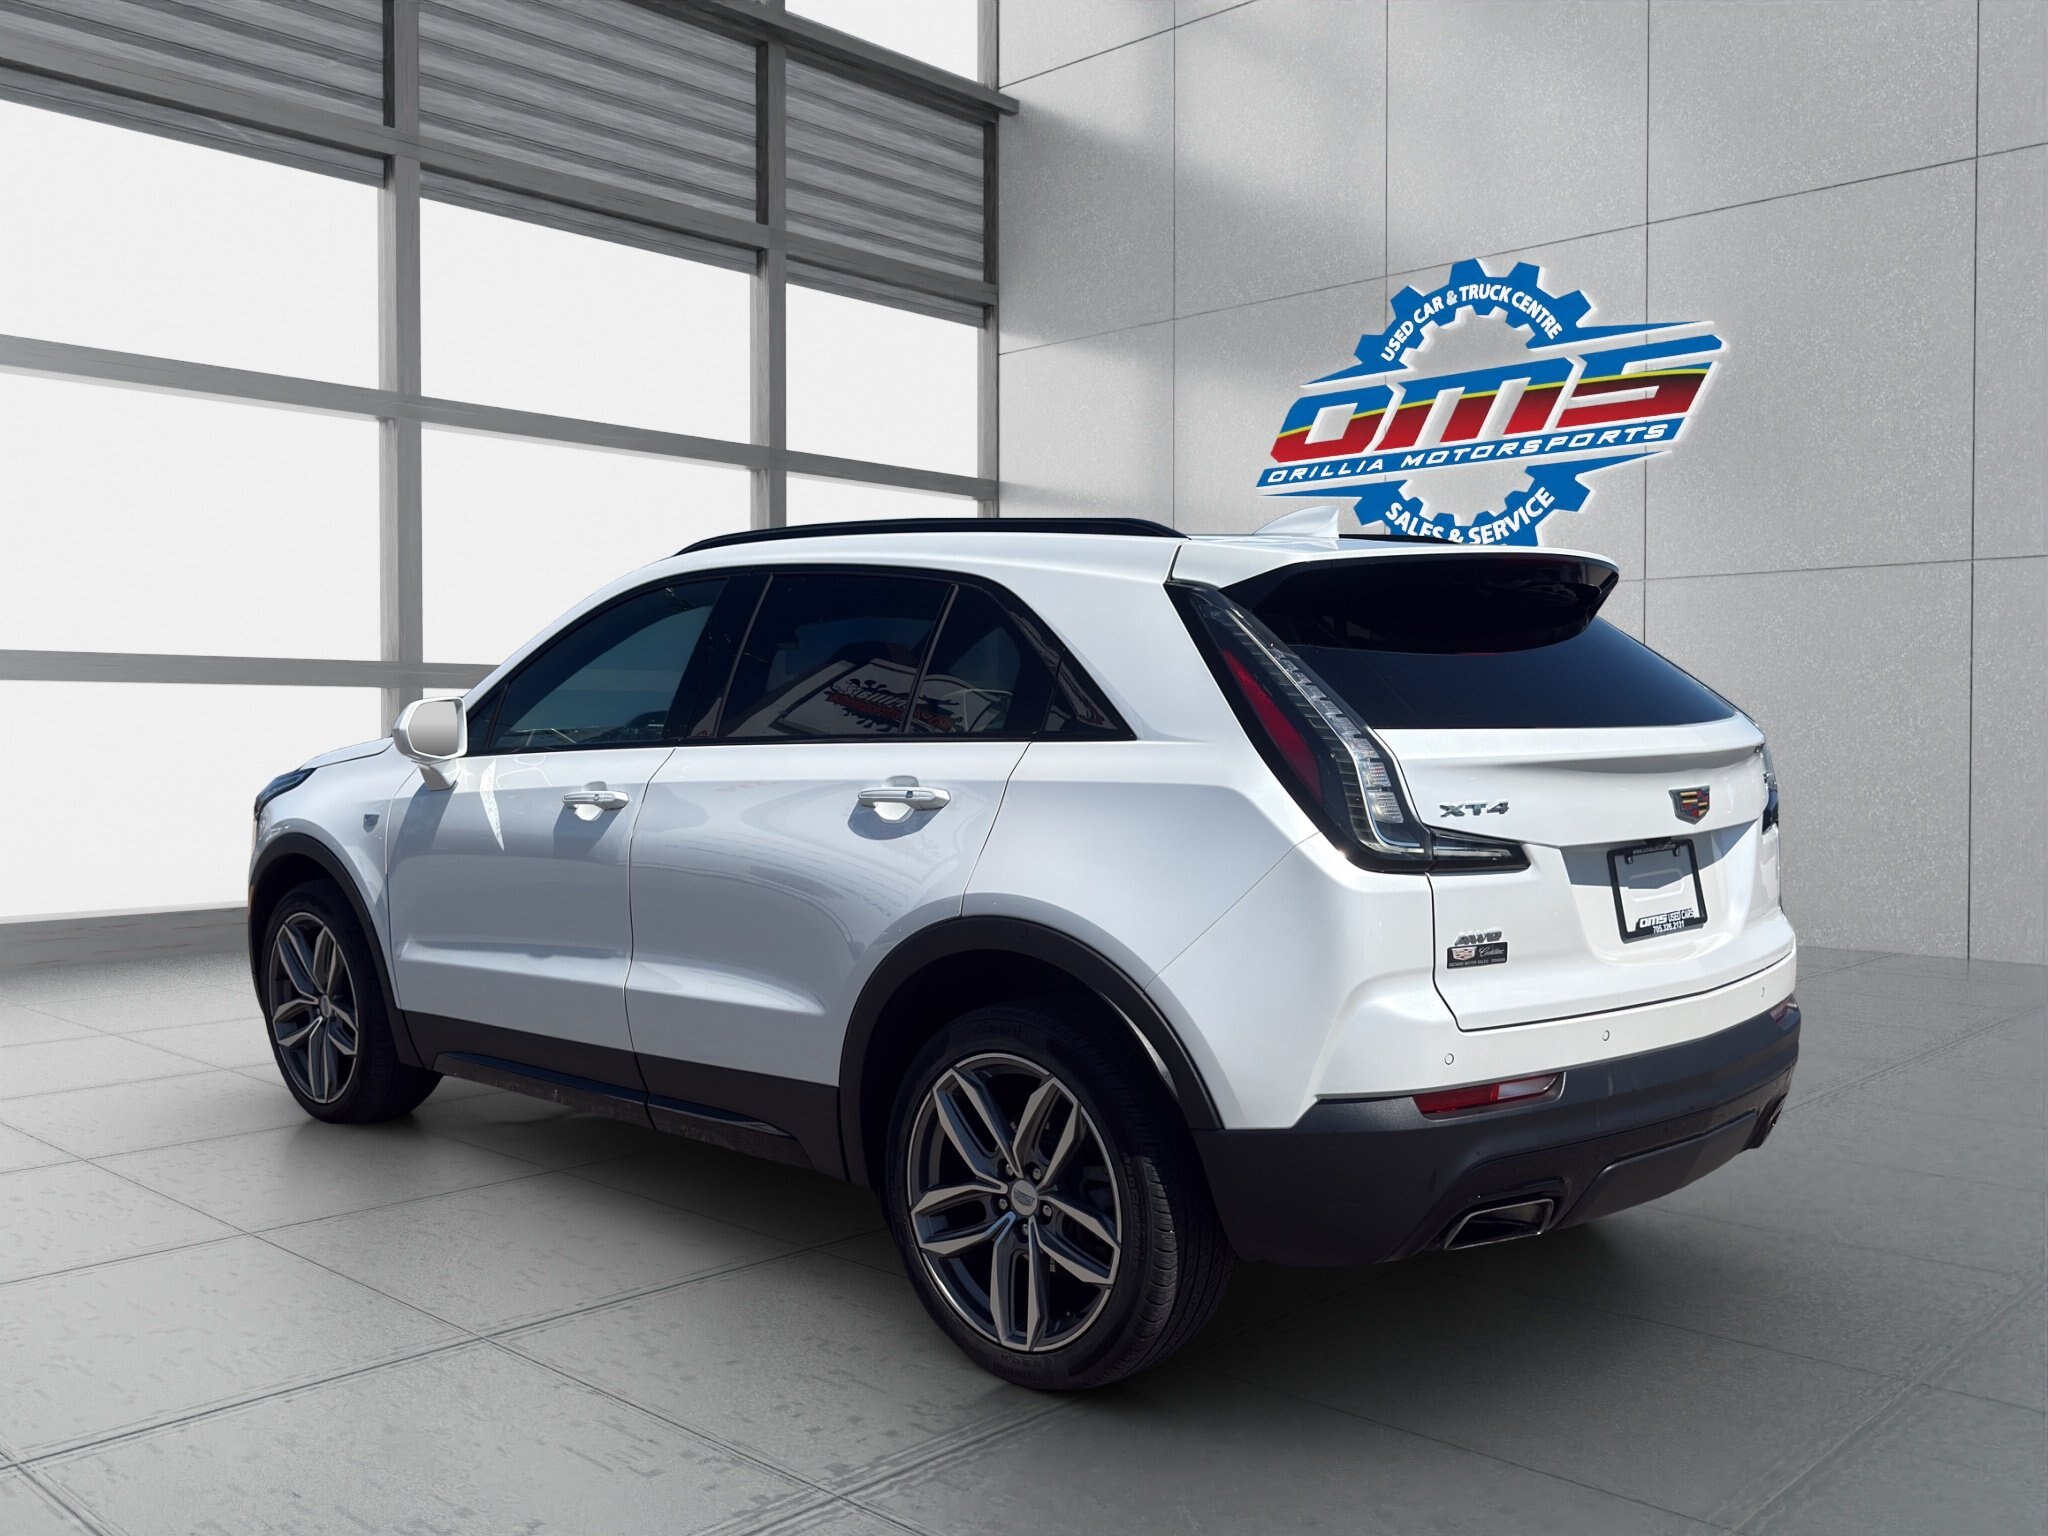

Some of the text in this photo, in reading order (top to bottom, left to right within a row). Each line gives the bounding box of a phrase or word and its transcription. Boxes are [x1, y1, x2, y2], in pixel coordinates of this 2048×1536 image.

[1380, 283, 1563, 362] USED CAR & TRUCK CENTRE
[1267, 423, 1669, 483] ORILLIA MOTORSPORTS
[1385, 486, 1556, 545] SALES & SERVICE
[1439, 801, 1509, 818] XT4
[1454, 931, 1502, 946] AWD
